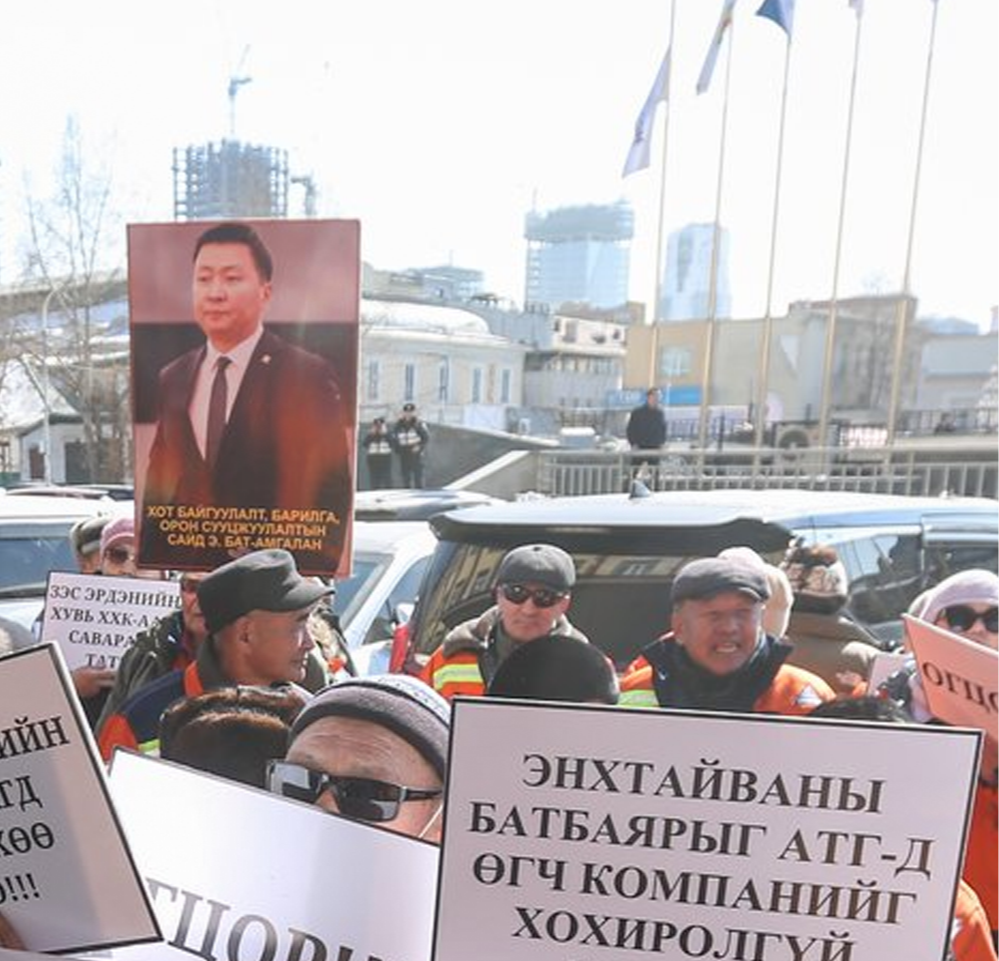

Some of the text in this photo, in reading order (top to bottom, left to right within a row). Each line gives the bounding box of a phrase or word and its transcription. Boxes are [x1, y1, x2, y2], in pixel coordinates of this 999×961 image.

[148, 504, 340, 524] ХОТ БАЙГУУЛАЛТ, БАРИЛГА,
[159, 520, 199, 532] ОРОН
[225, 536, 322, 550] БАТ-АМГАЛАН
[50, 585, 82, 600] ЗЭС
[51, 606, 94, 622] ХУВЬ
[522, 753, 886, 815] ЭНХТАЙВАНЫ
[469, 801, 937, 880] БАТБАЯРЫГ АТГ-Д
[473, 852, 917, 926] ӨГЧ КОМПАНИЙГ
